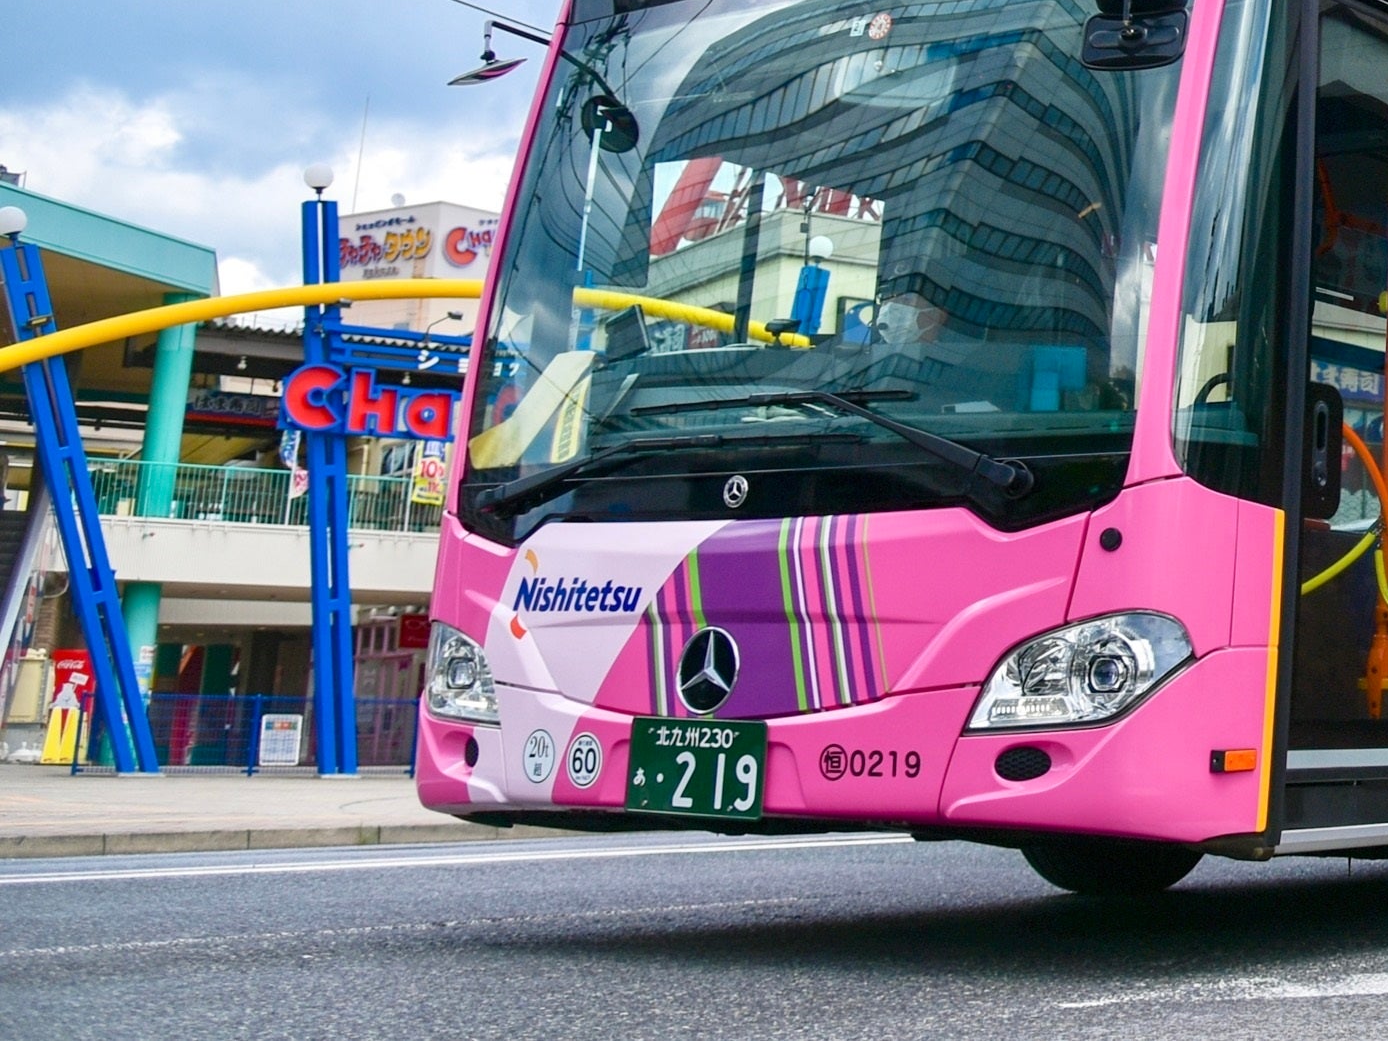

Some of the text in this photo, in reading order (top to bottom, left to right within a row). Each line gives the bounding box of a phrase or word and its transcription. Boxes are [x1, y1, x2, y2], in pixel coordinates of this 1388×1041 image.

[512, 576, 642, 612] Nishitetsu
[528, 735, 549, 758] 20t
[571, 747, 597, 774] 60
[849, 750, 921, 778] 0219
[632, 767, 646, 787] あ
